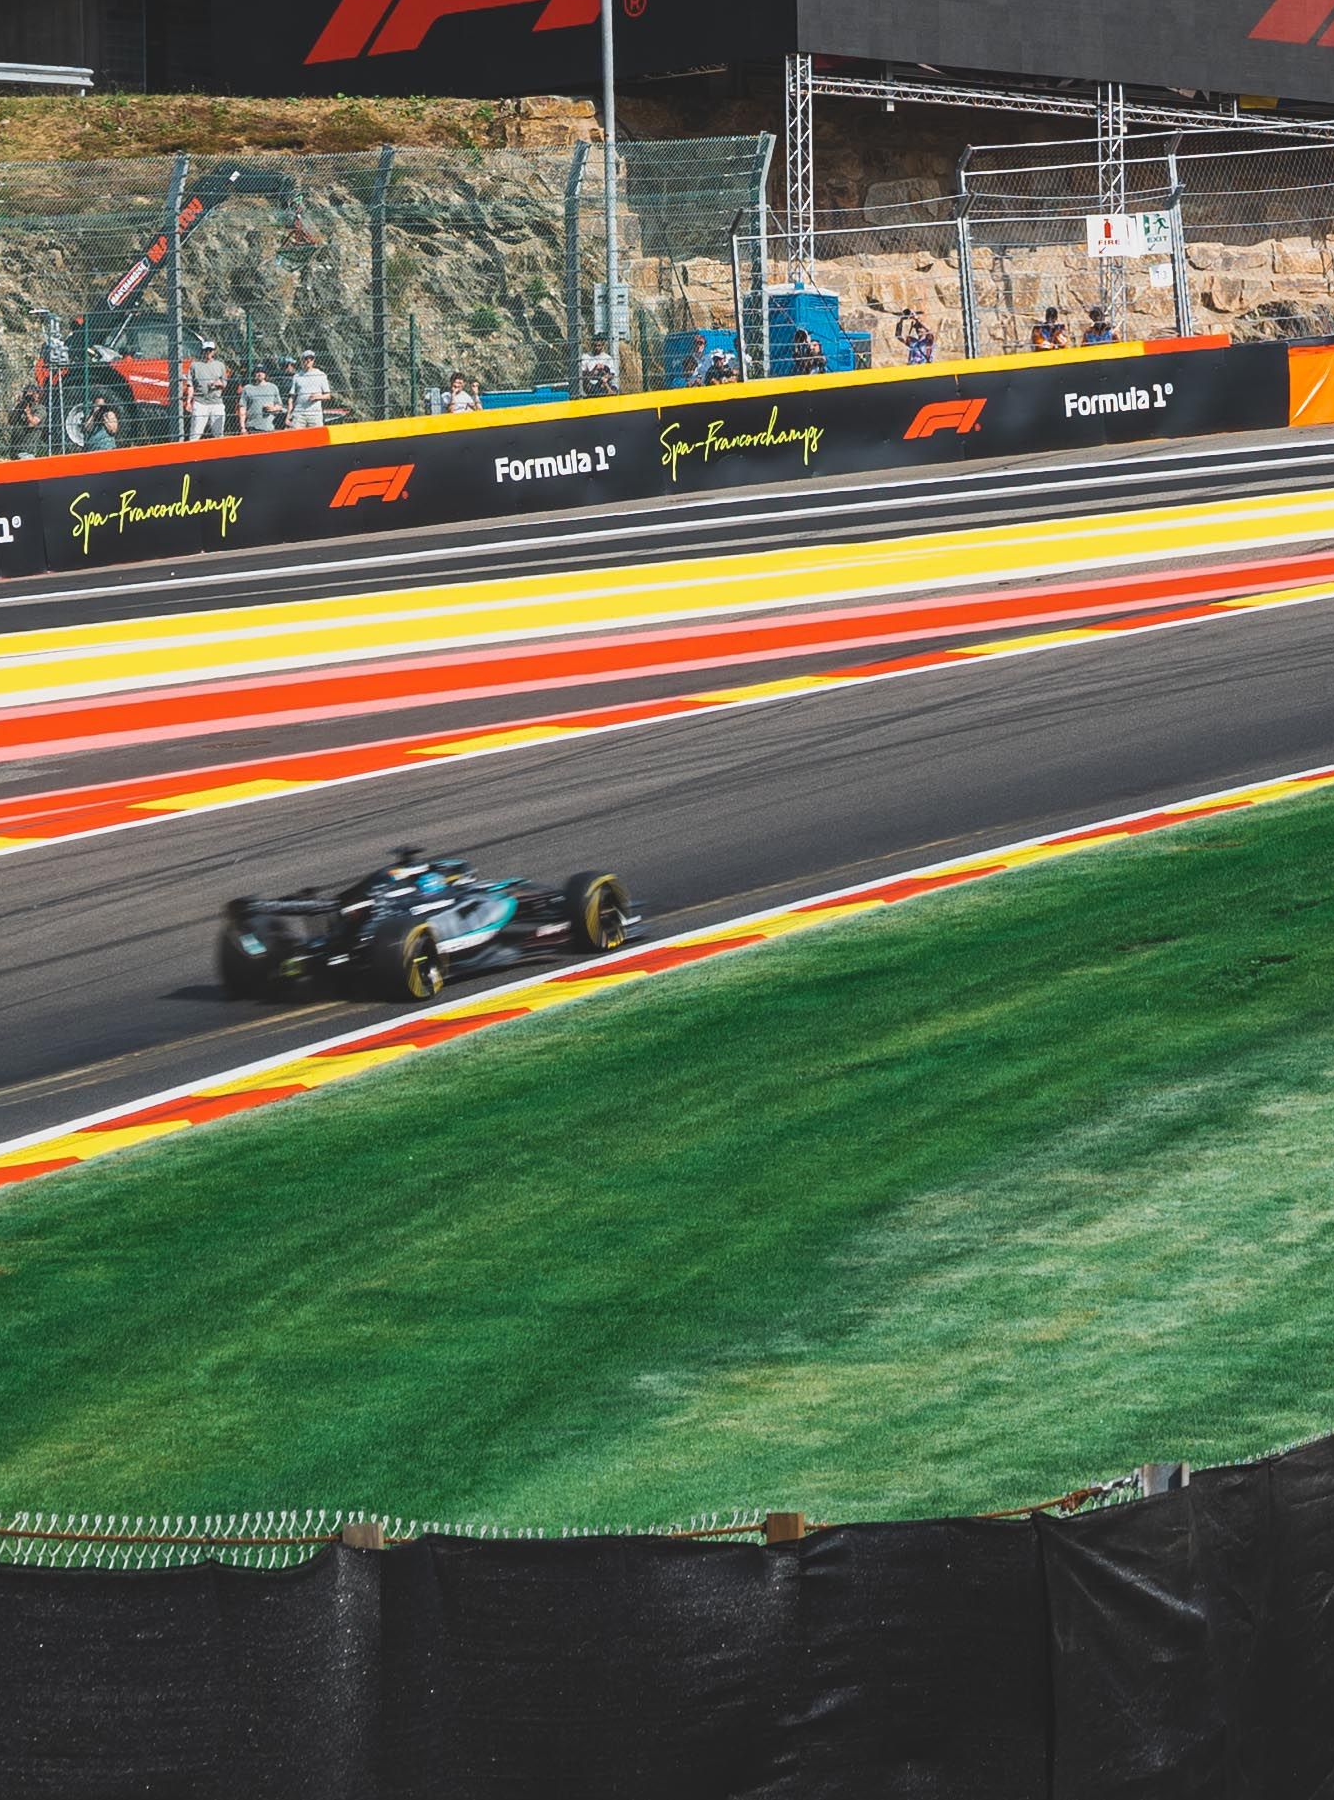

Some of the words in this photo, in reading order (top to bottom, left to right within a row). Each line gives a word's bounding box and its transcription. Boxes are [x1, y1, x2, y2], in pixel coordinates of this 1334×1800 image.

[1146, 235, 1168, 244] EXIT
[902, 397, 988, 440] F1
[1064, 387, 1150, 418] Formula
[660, 405, 824, 480] Spa-Francorchamps
[329, 463, 416, 509] F1
[494, 449, 592, 483] Formula
[70, 473, 243, 554] Spa-Francorchamps
